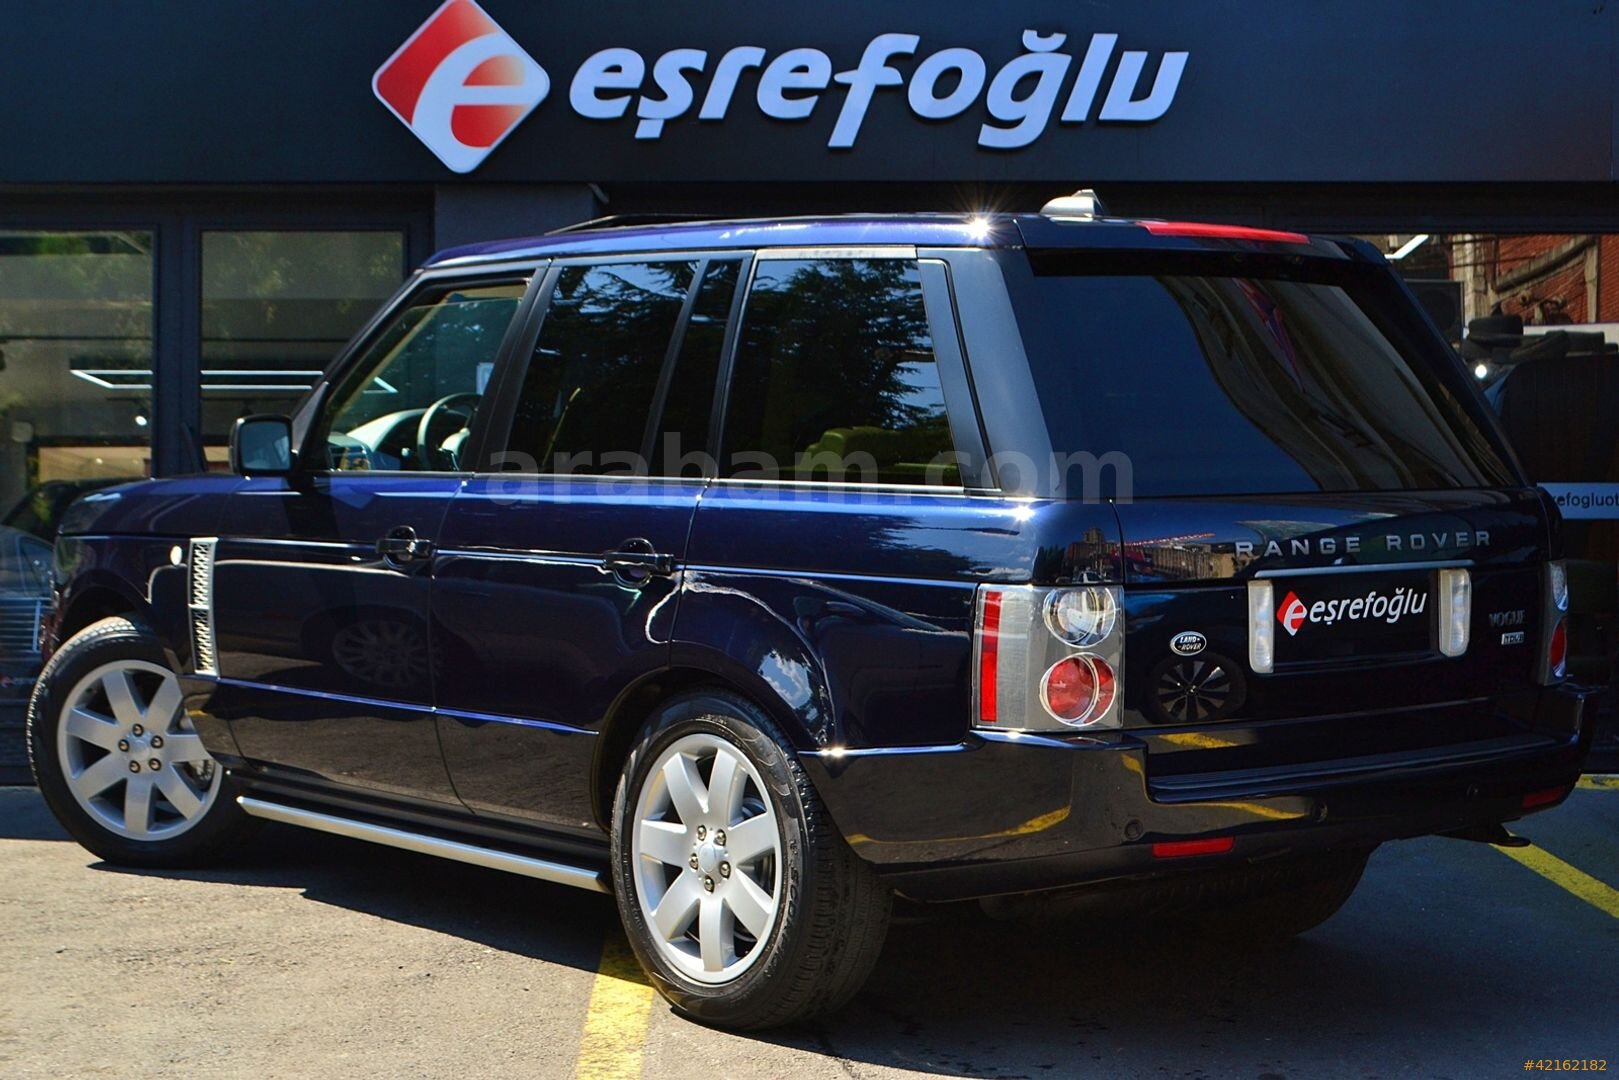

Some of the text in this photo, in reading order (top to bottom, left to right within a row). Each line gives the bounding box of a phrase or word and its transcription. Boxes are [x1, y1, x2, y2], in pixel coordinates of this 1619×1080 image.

[569, 29, 1190, 149] eşrefoğlu
[1235, 530, 1492, 557] RANGE ROVER
[1309, 587, 1428, 626] eşrefoğlu
